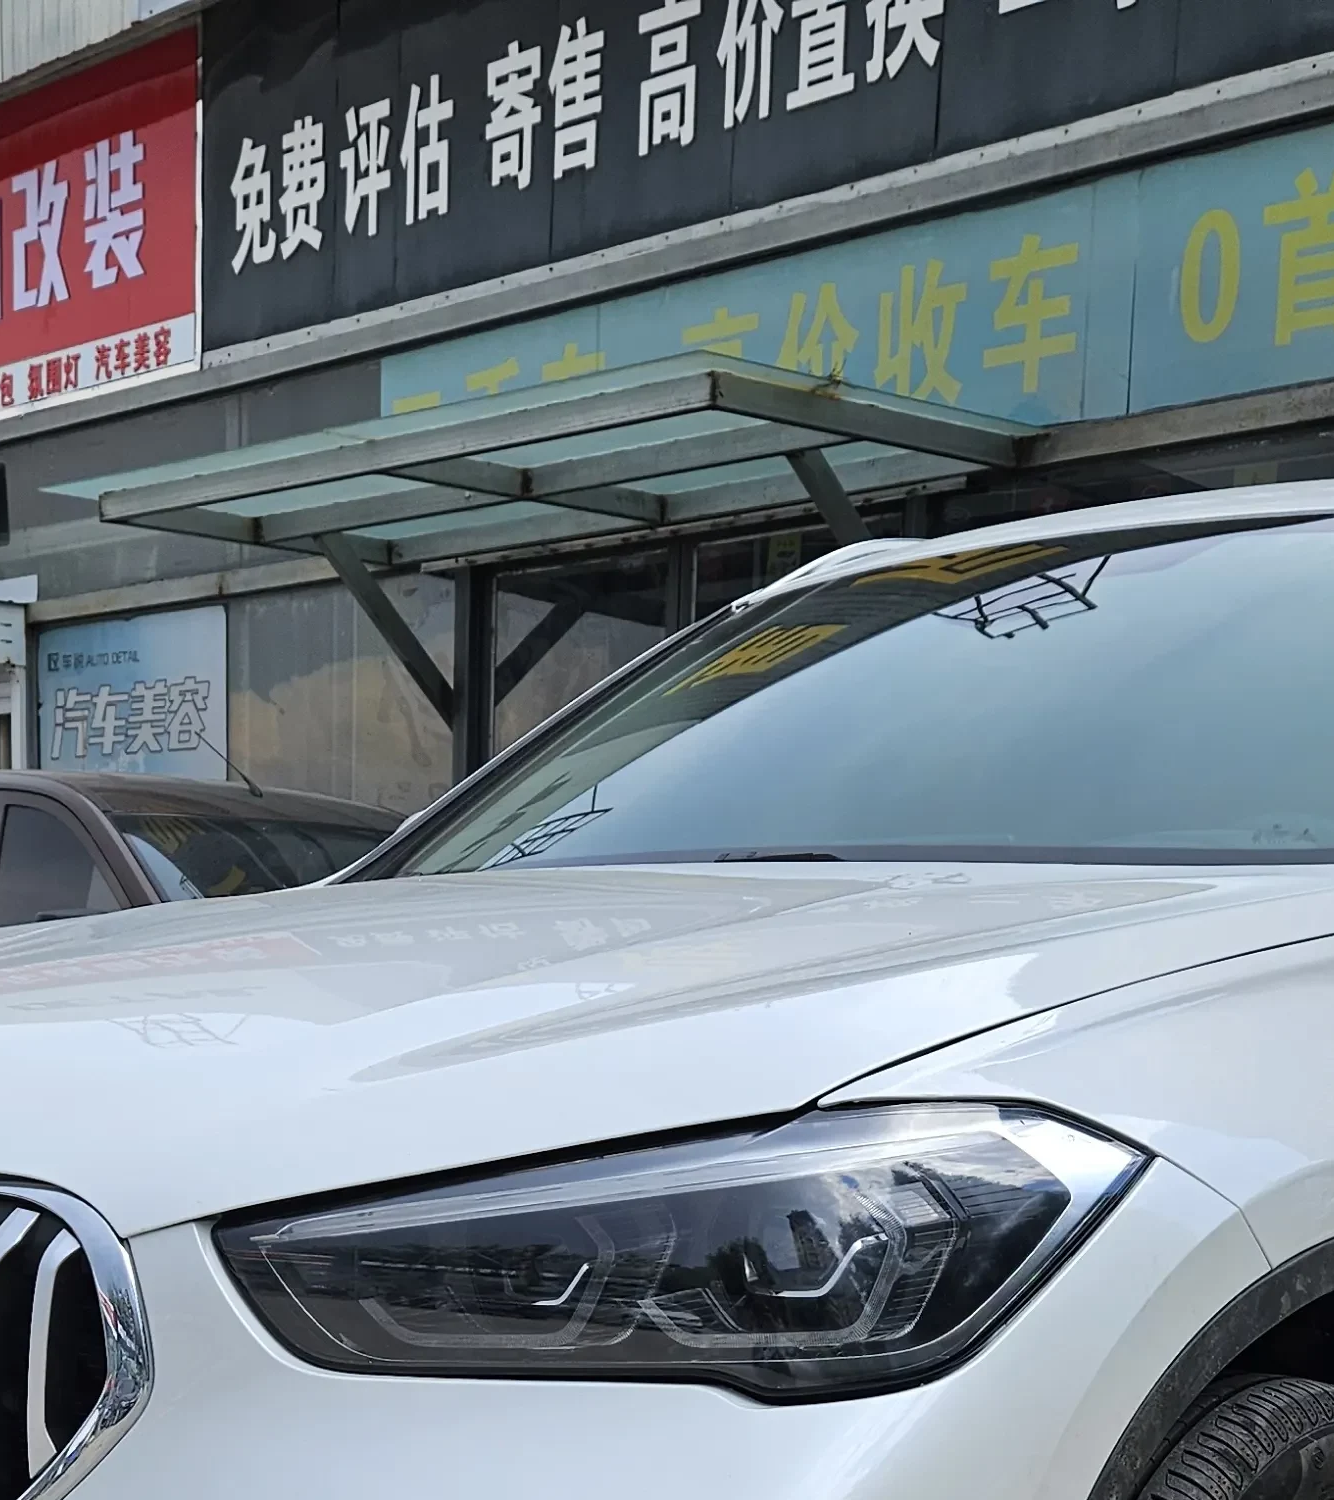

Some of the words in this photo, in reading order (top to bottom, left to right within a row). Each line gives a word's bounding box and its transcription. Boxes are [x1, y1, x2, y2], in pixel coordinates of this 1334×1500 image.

[230, 75, 454, 275] 免费评估
[486, 17, 604, 190] 寄售
[27, 352, 81, 401] 氛围灯
[94, 326, 172, 381] 汽车美容
[50, 675, 211, 760] 汽车美容
